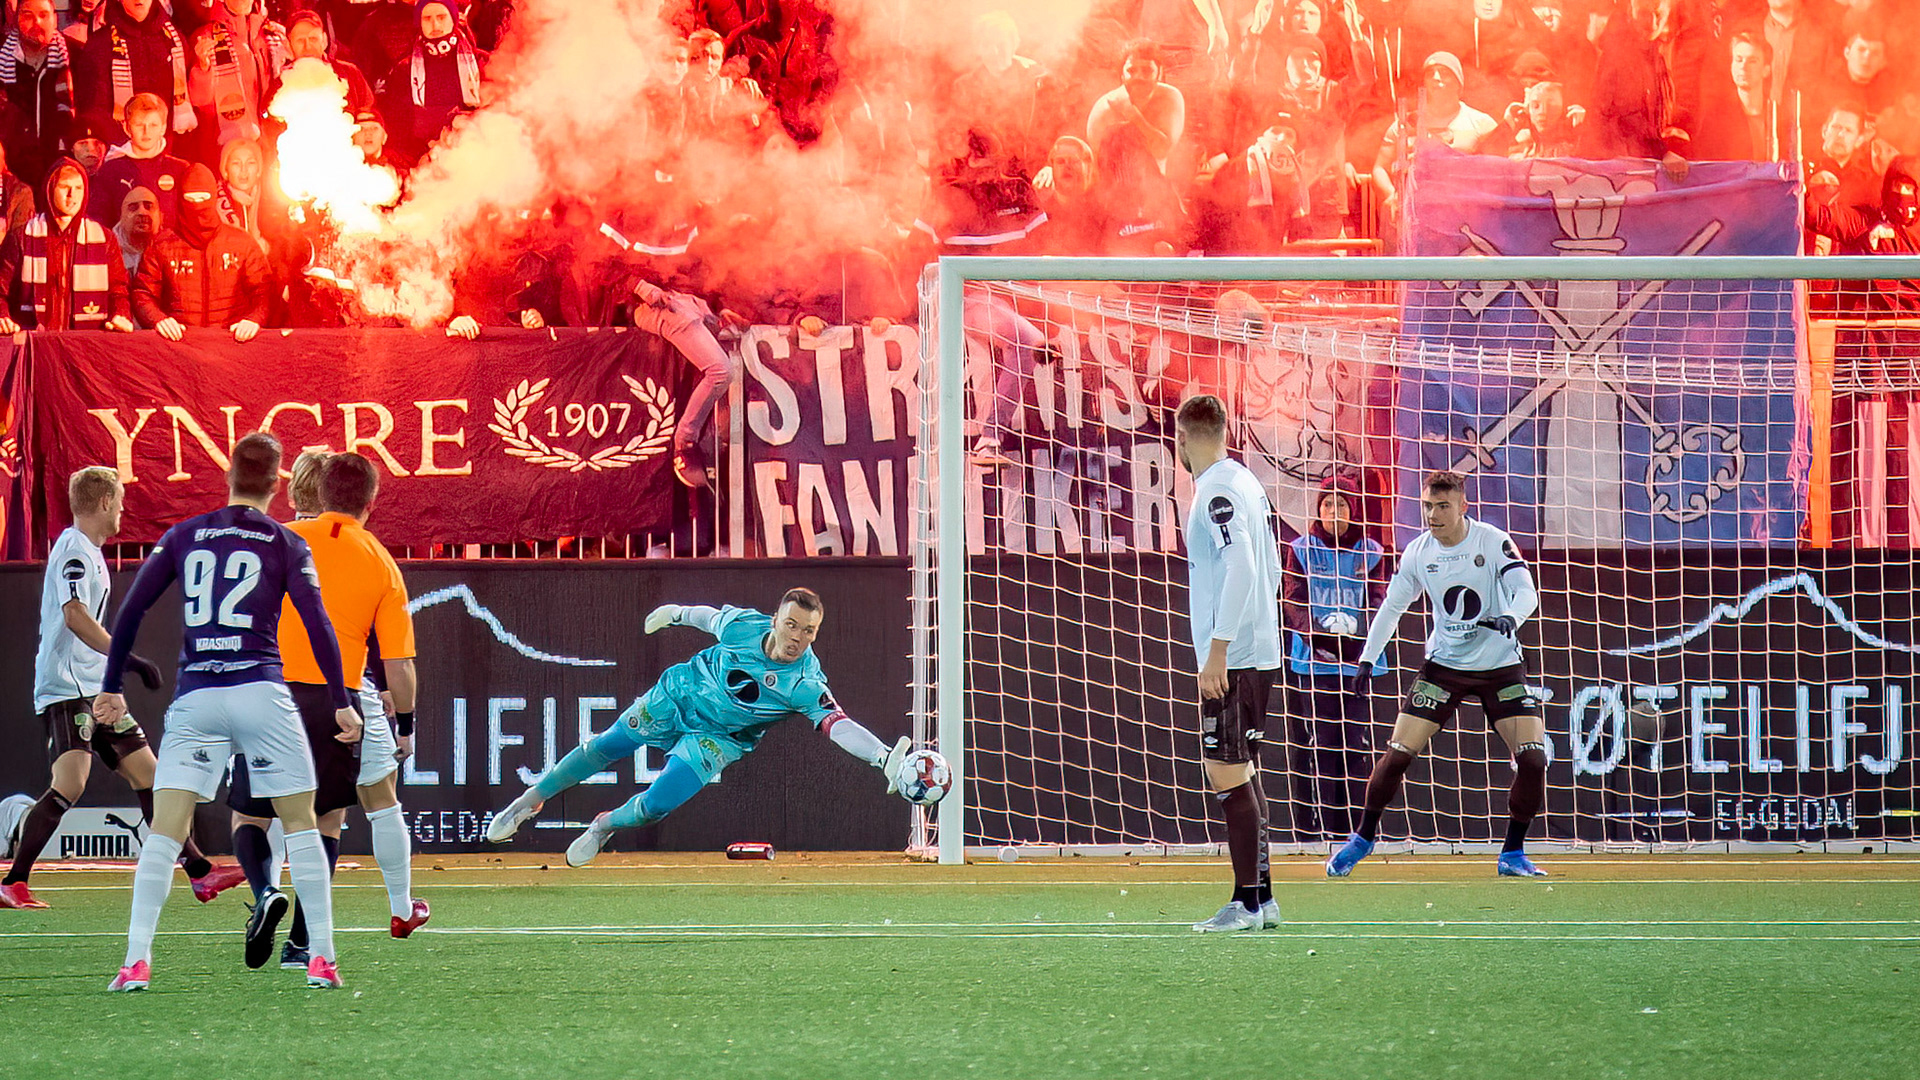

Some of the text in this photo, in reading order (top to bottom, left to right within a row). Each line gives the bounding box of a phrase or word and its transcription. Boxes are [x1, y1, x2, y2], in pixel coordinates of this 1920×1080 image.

[544, 402, 631, 438] 1907
[184, 549, 262, 629] 92
[403, 697, 722, 788] LIFJEL
[1717, 798, 1860, 831] EGGEDAL
[60, 834, 130, 858] PUMA
